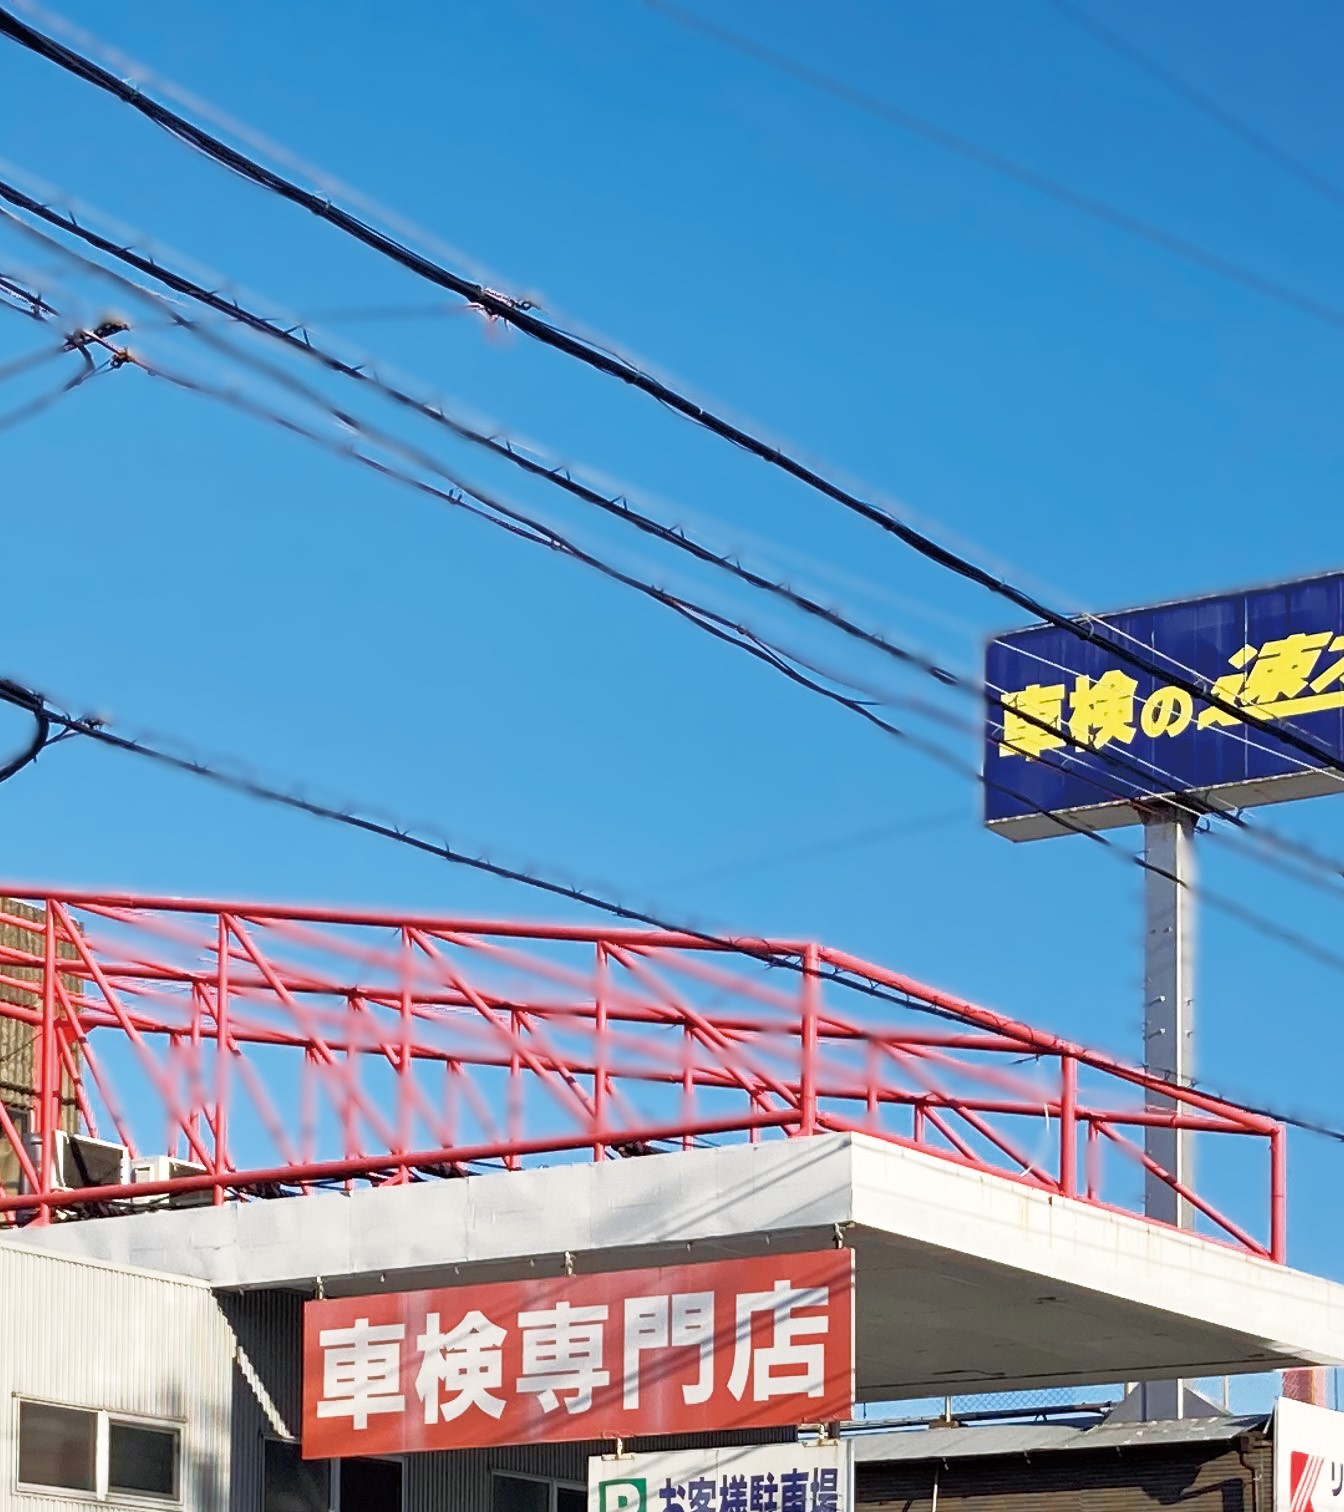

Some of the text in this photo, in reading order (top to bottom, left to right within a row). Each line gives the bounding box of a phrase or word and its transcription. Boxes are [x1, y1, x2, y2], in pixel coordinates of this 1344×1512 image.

[317, 1280, 830, 1430] 車検専門店
